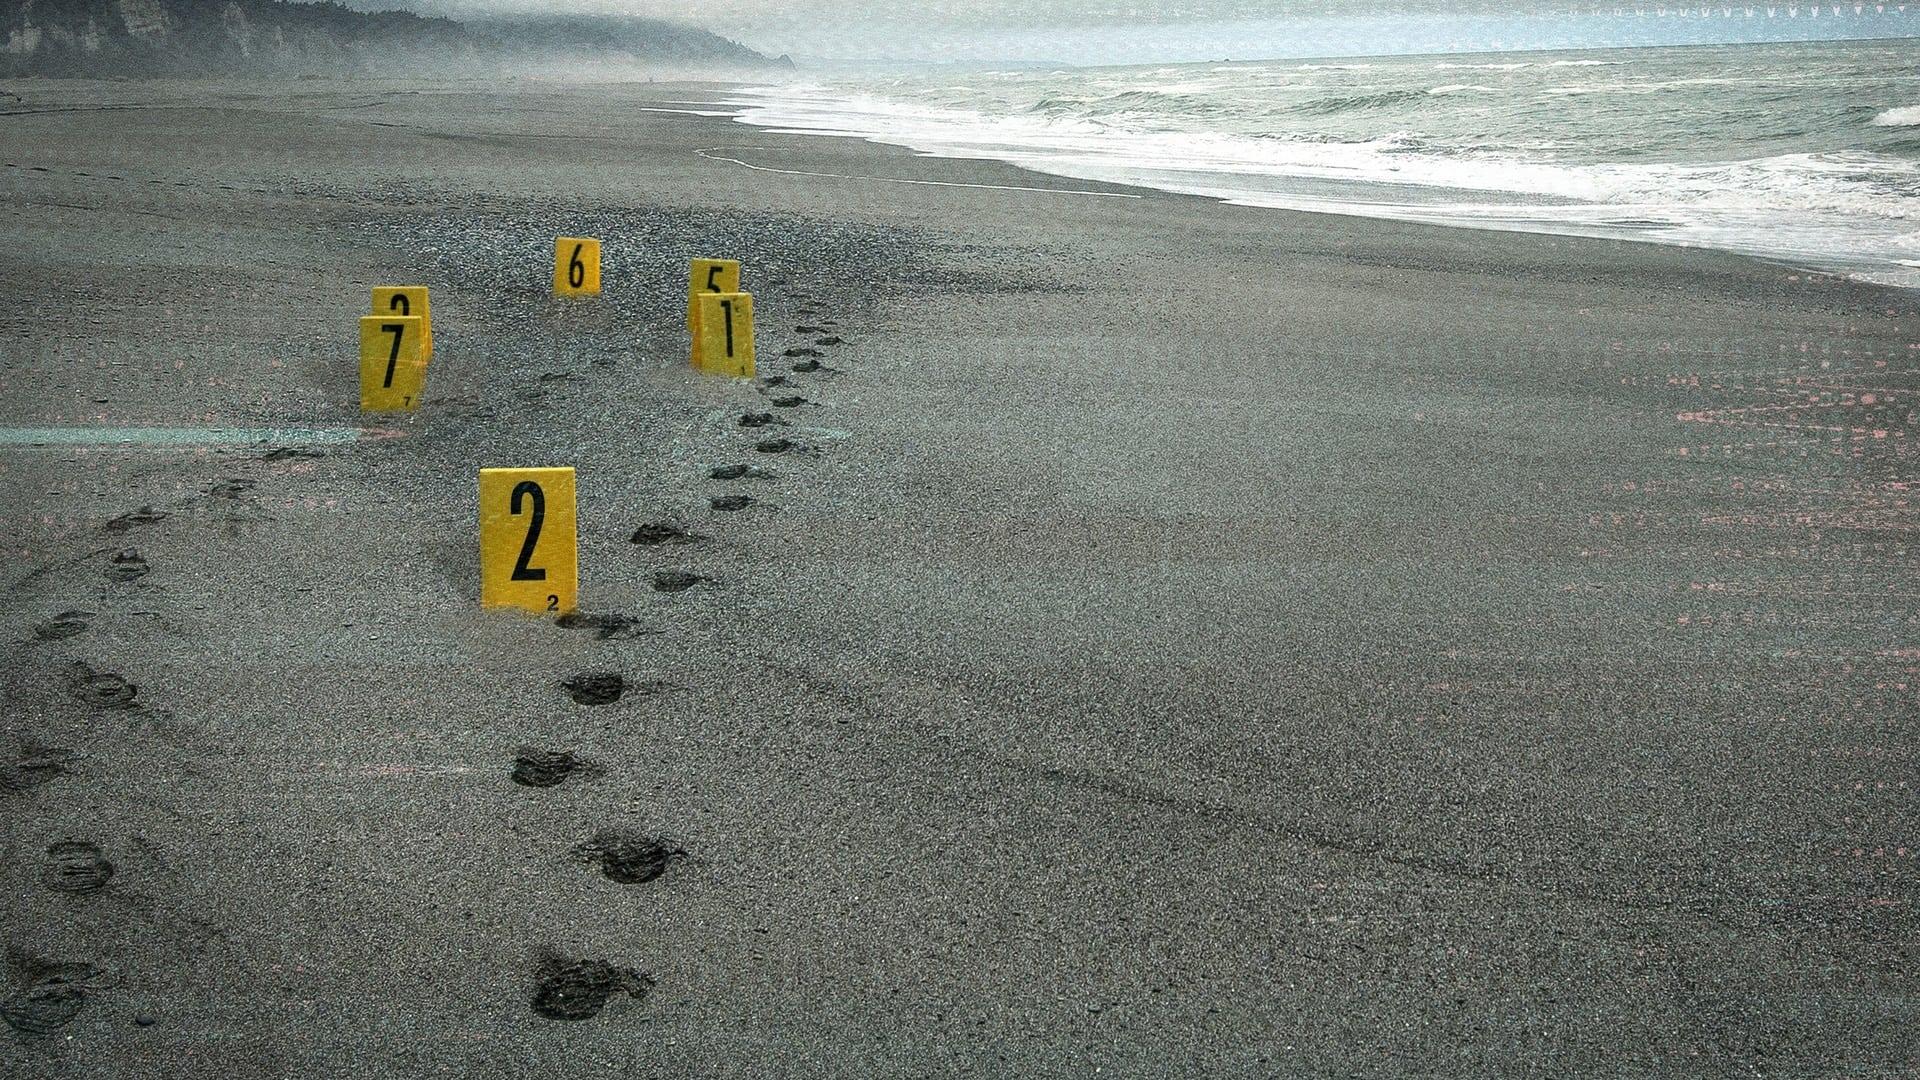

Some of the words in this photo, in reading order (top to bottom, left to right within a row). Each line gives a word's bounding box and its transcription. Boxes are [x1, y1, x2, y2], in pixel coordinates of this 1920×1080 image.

[567, 243, 585, 289] 6
[720, 299, 734, 358] 1
[381, 323, 405, 389] 7
[403, 396, 412, 407] 7
[510, 480, 546, 582] 2
[546, 594, 560, 612] 2
